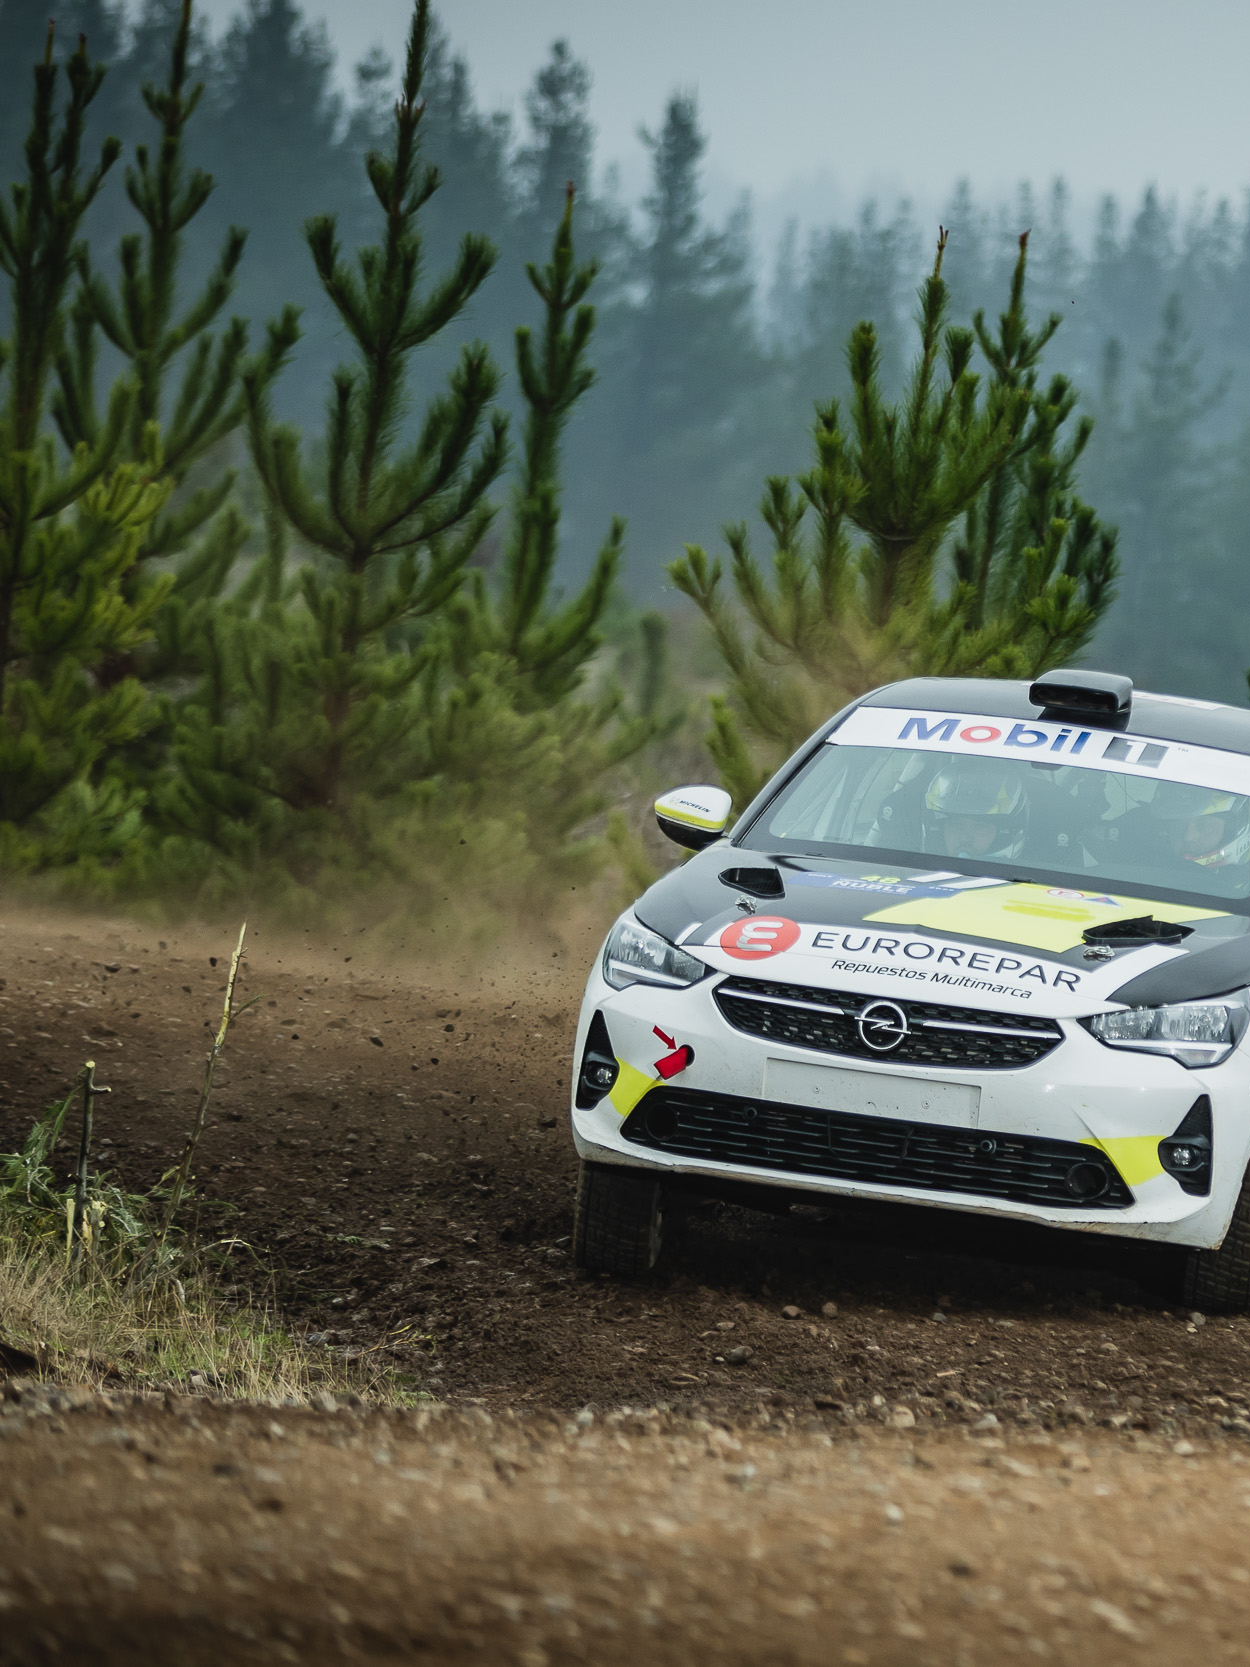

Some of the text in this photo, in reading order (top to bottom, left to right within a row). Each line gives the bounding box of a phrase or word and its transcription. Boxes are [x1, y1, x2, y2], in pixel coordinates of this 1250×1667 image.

[897, 716, 1092, 755] Mobil
[679, 800, 711, 813] MICHELIN
[811, 931, 1082, 993] EUROREPAR
[831, 959, 1033, 1000] Repuestos Multimarca
